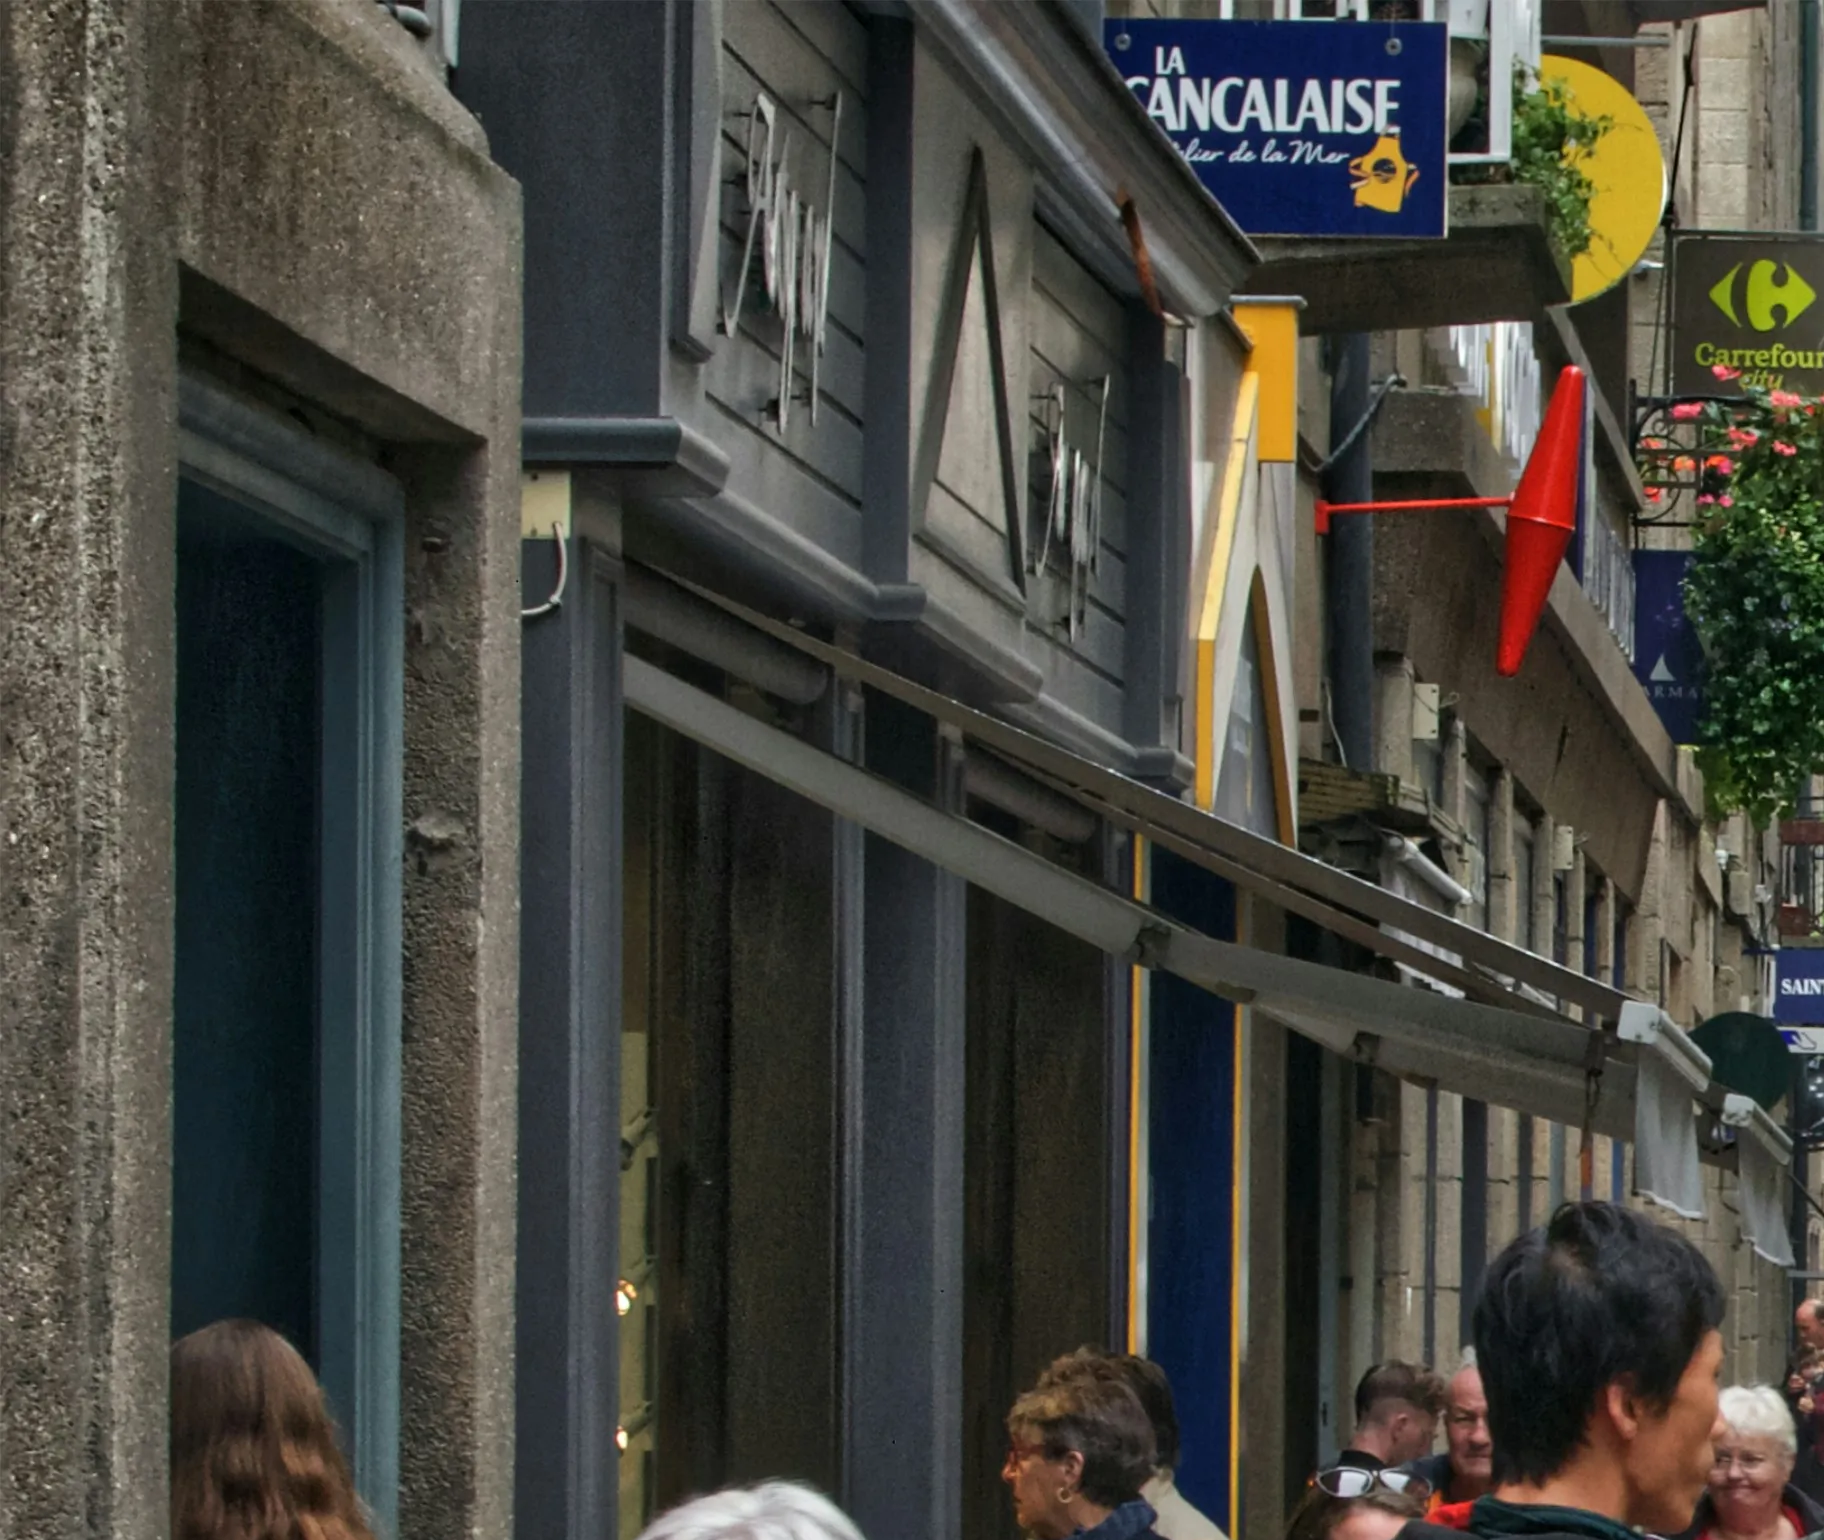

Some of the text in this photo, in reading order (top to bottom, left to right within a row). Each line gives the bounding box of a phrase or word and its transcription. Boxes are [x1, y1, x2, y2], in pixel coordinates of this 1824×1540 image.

[1155, 46, 1186, 75] LA
[1229, 142, 1257, 164] de
[1261, 140, 1288, 164] la
[1288, 140, 1350, 165] Mer
